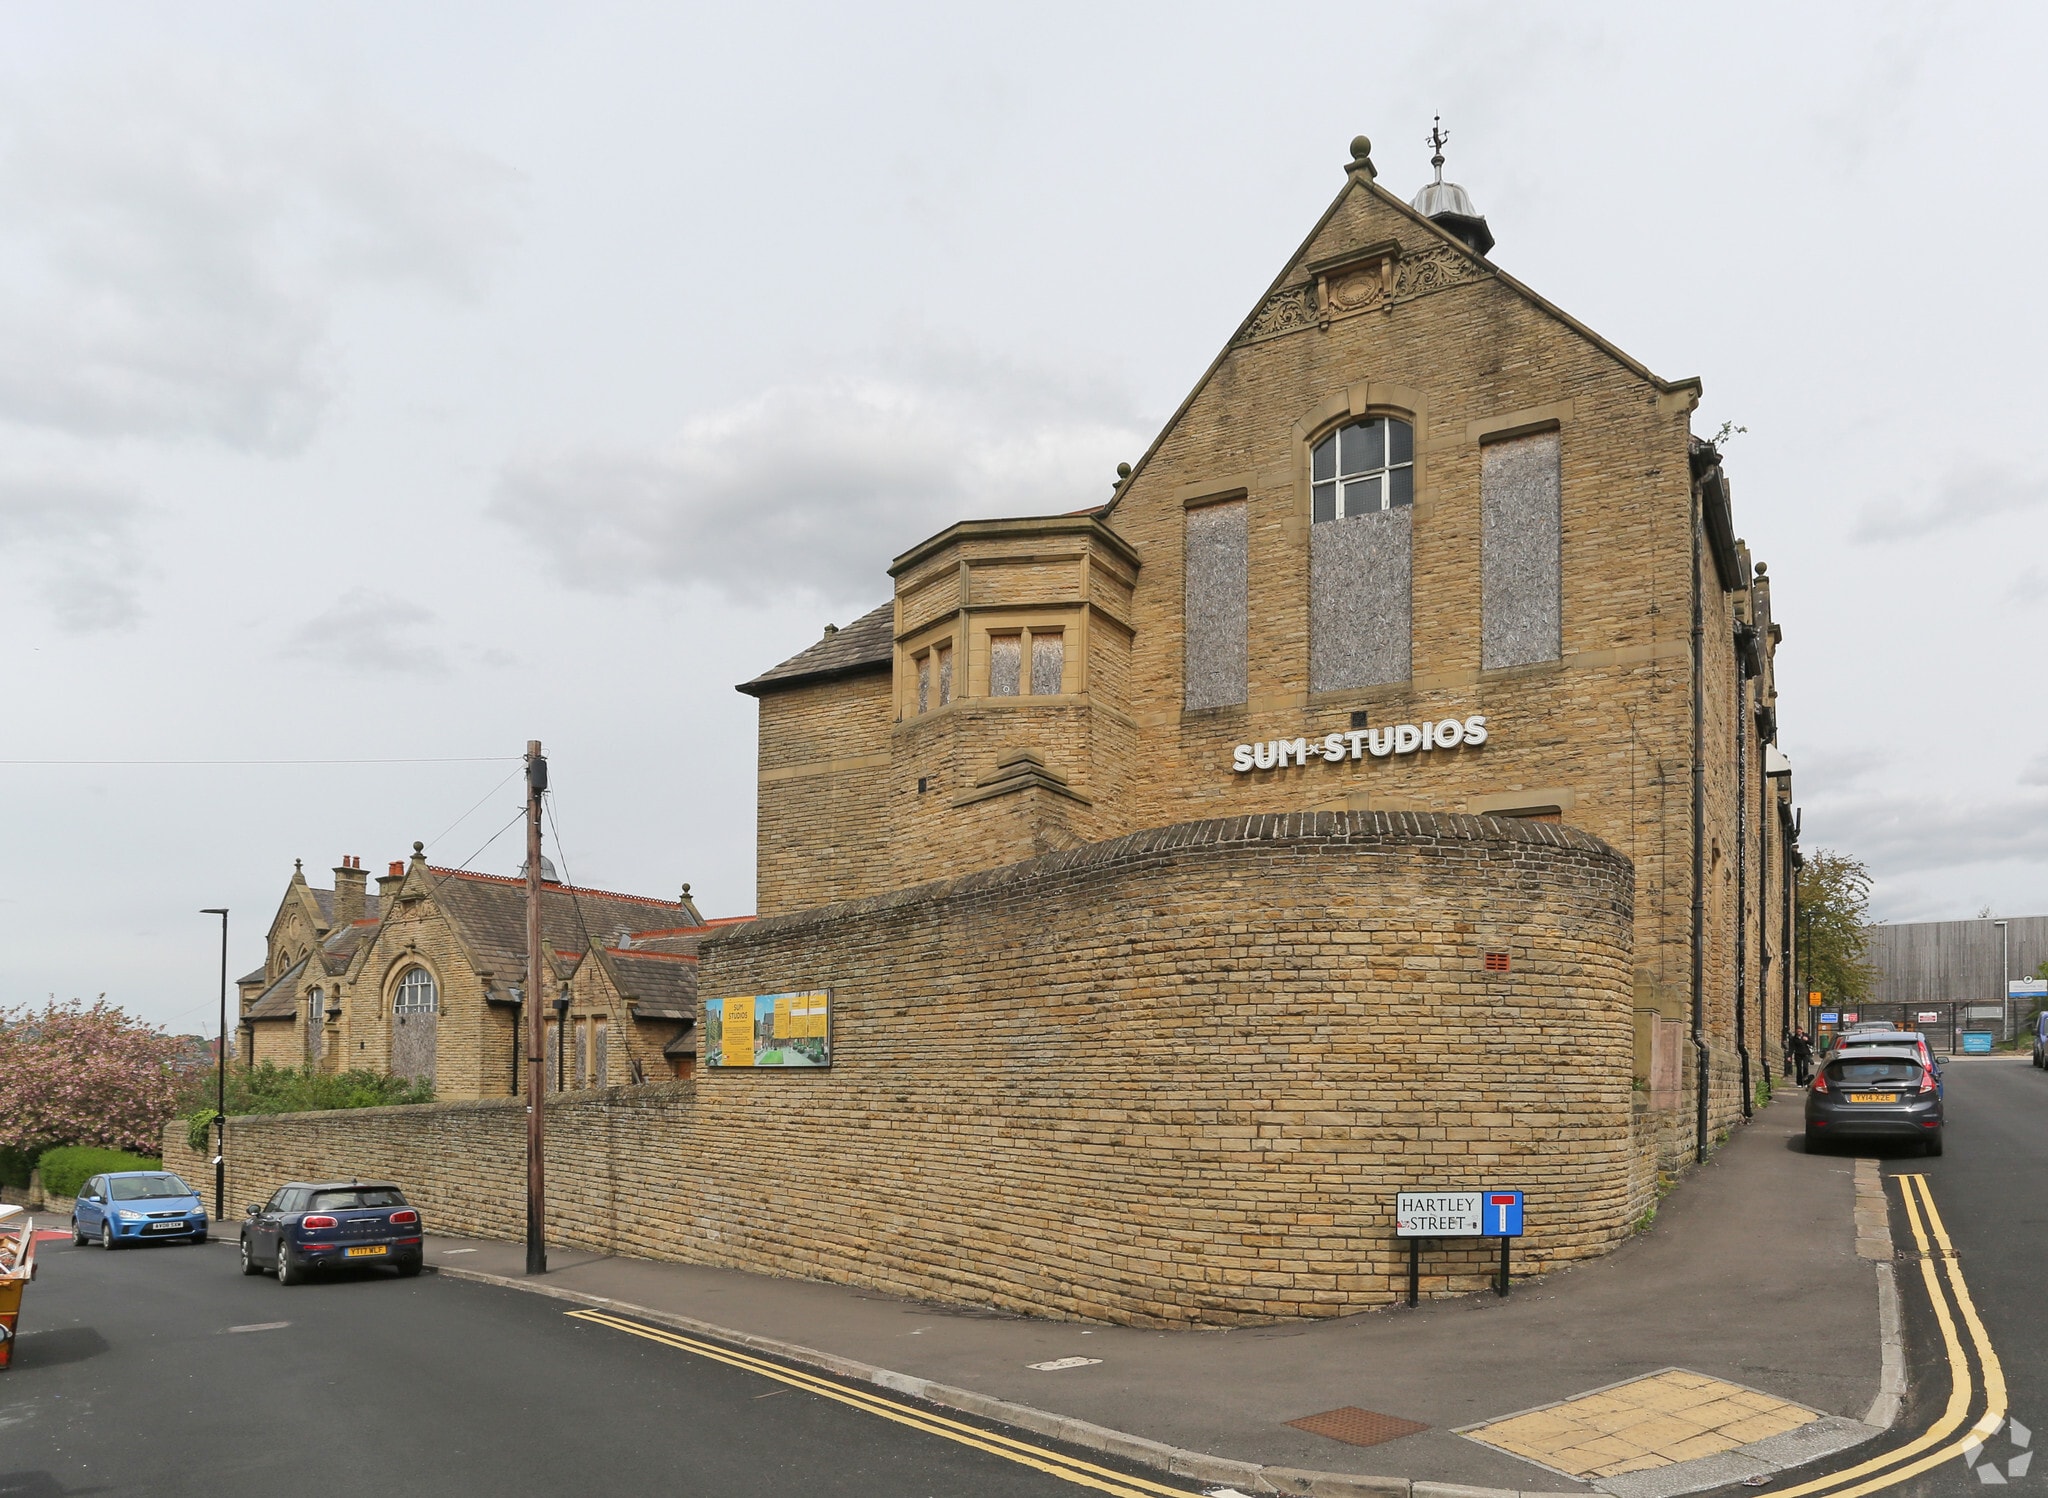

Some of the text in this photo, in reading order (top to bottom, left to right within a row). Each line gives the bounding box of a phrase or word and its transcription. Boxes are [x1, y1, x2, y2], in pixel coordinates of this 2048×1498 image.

[1232, 737, 1307, 772] SUM
[1323, 715, 1488, 762] STUDIOS
[728, 1011, 748, 1020] STUDIOS
[1876, 1094, 1891, 1102] XZE
[1402, 1198, 1475, 1212] HARTLEY
[1410, 1216, 1466, 1230] STREET
